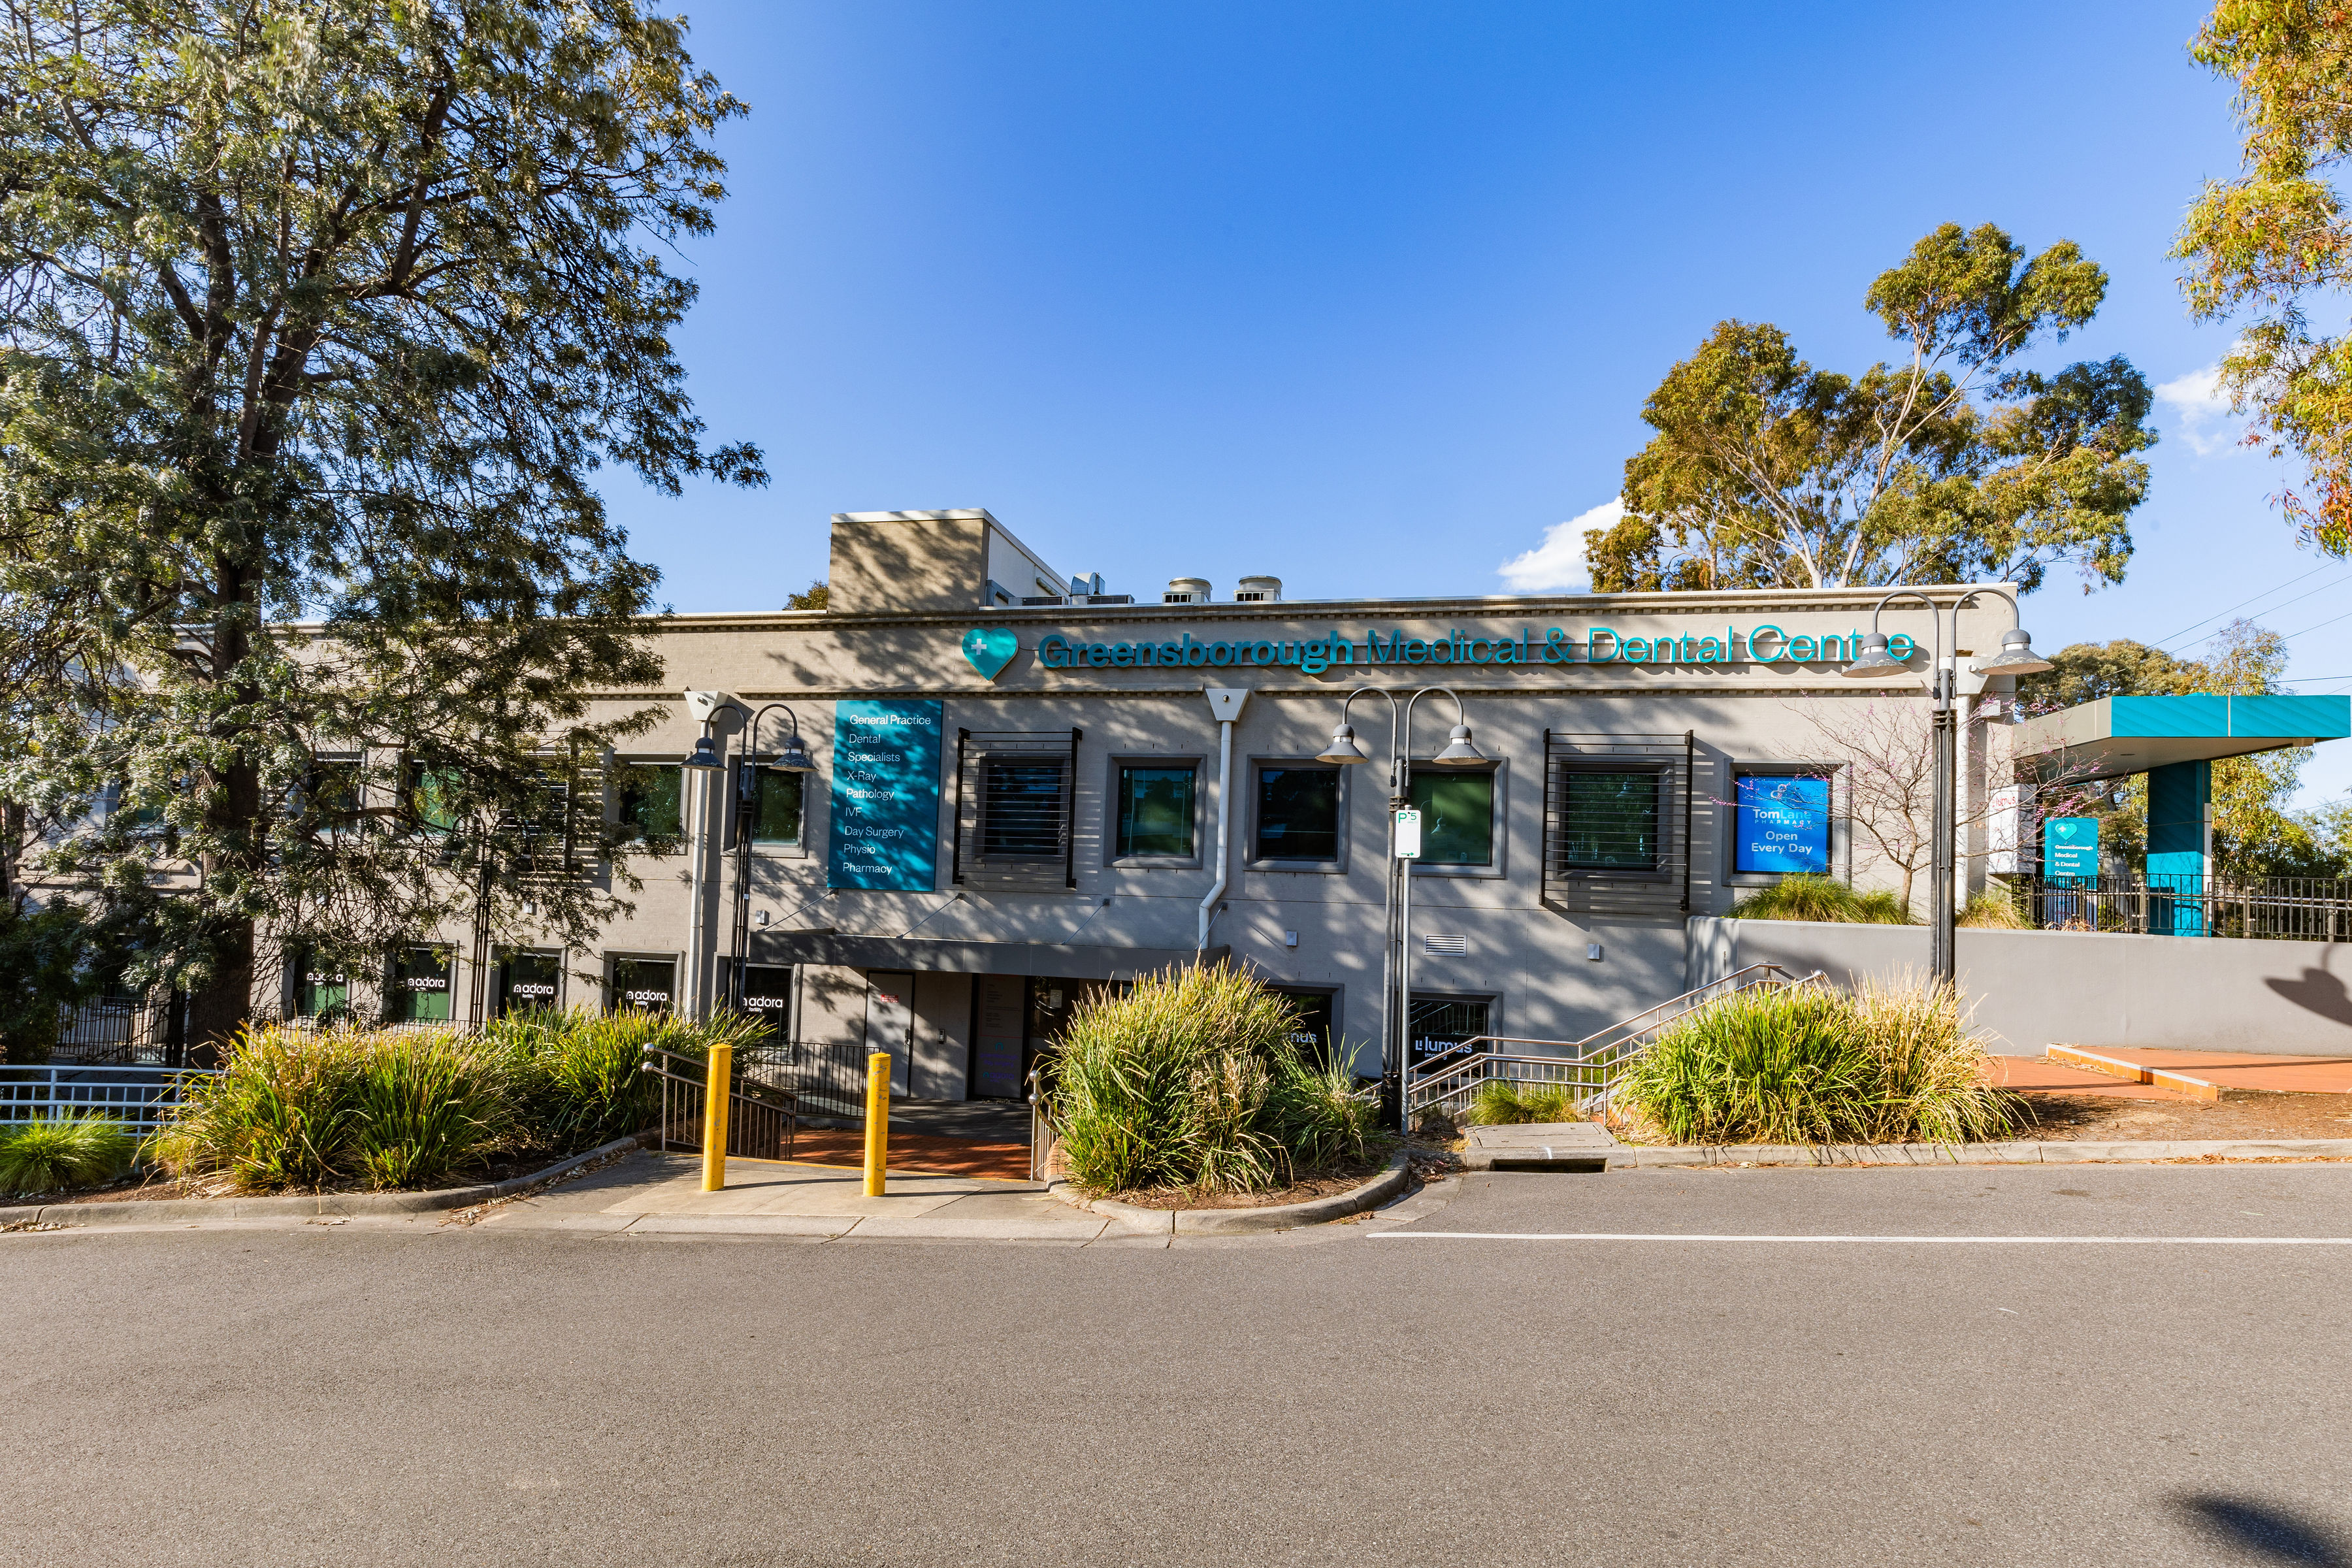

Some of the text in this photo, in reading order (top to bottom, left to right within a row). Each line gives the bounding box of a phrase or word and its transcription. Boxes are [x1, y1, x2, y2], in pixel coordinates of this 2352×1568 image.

[1039, 625, 1914, 674] Greensborough Medical & Dental Cente
[849, 715, 931, 725] General Practice
[849, 734, 881, 743] Dental
[848, 752, 900, 763] Specialists
[847, 771, 876, 782] X-Ray
[846, 789, 894, 800] Pathology
[845, 807, 862, 817] IVF
[1398, 813, 1407, 823] P
[845, 826, 904, 838] Day Surgery
[1766, 831, 1798, 841] Open
[844, 844, 875, 855] Physio
[1752, 843, 1812, 855] Every Day
[843, 862, 892, 875] Pharmacy
[416, 976, 445, 987] adora
[523, 983, 553, 994] adora
[635, 990, 667, 1001] adora
[749, 996, 783, 1007] adora
